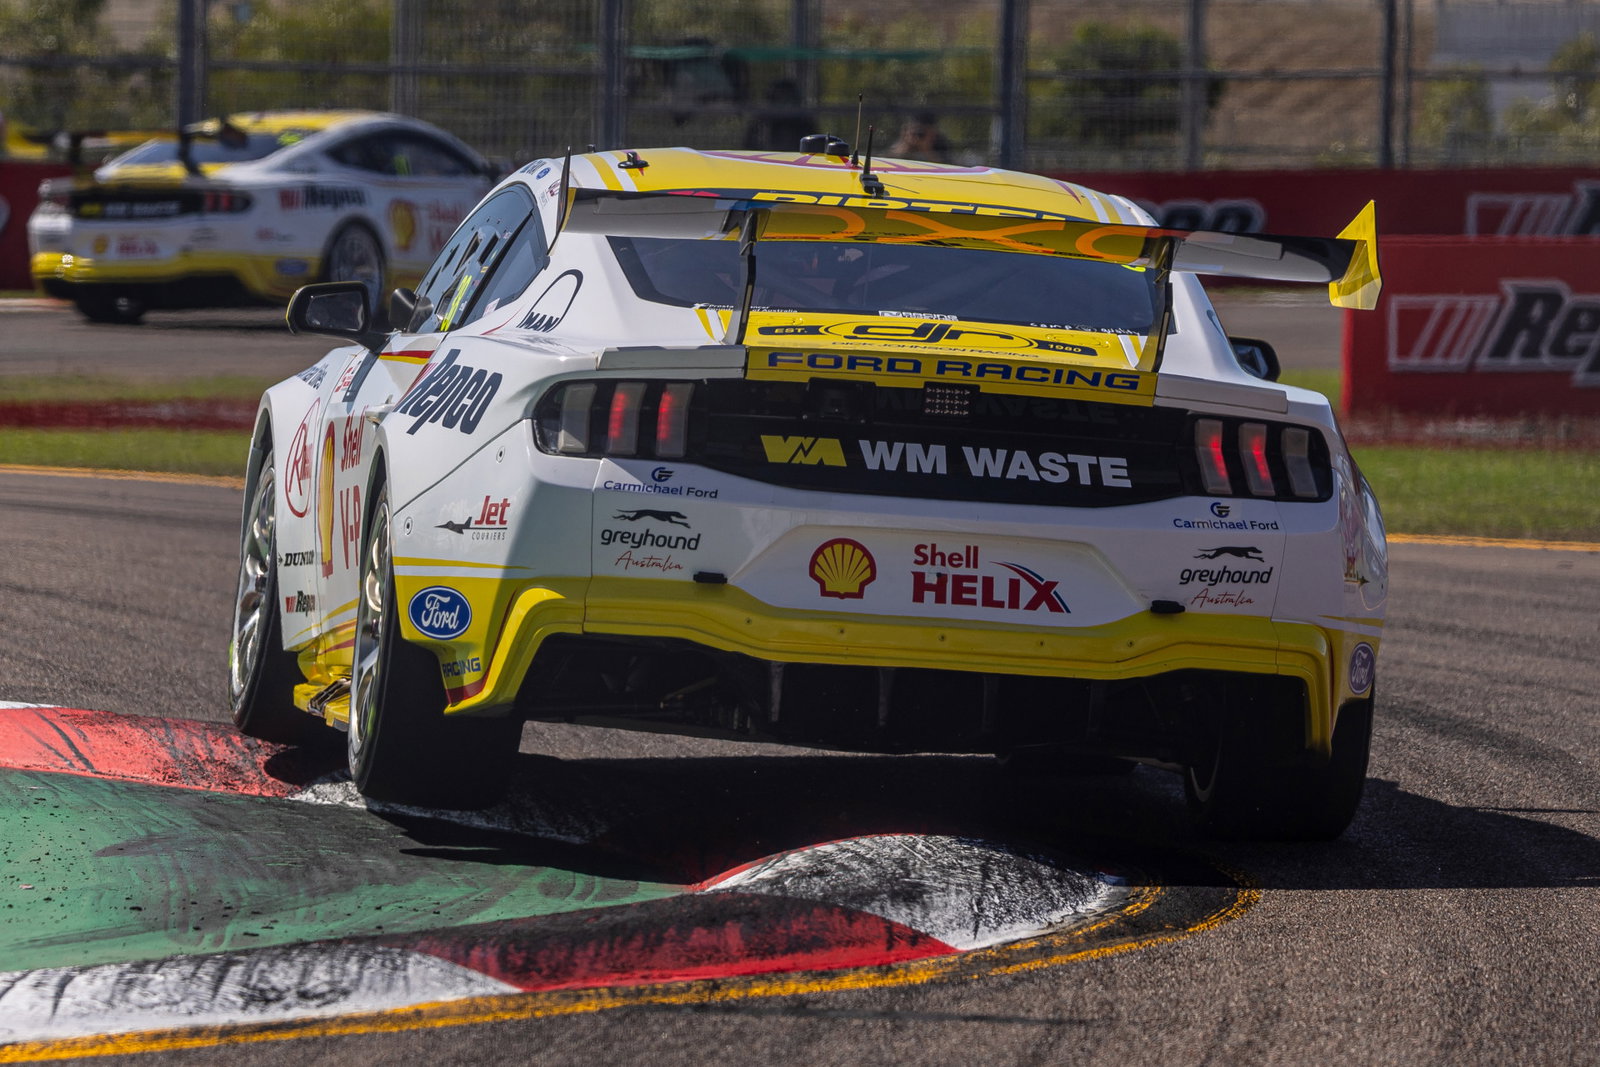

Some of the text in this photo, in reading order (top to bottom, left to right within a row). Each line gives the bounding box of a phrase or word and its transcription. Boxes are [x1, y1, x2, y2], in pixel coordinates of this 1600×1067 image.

[522, 311, 560, 333] MAN
[878, 344, 966, 352] JOHNSON
[968, 348, 1040, 359] RACING
[1048, 343, 1082, 353] 1980
[769, 351, 1139, 390] FORD RACING
[397, 349, 503, 434] Repco
[859, 440, 947, 475] WM
[963, 446, 1132, 488] WASTE
[603, 480, 719, 499] Carmichael Ford
[475, 495, 511, 525] Jet
[1173, 518, 1279, 530] Carmichael Ford
[471, 531, 506, 540] COURIERS
[601, 528, 701, 551] greyhound
[284, 549, 315, 567] DUNLOP
[615, 550, 684, 573] Australia
[913, 543, 979, 569] Shell
[911, 561, 1072, 613] HELIX
[1179, 565, 1274, 587] greyhound
[1191, 588, 1254, 609] Australia
[421, 593, 460, 631] Ford
[442, 656, 481, 677] RACING
[1352, 649, 1371, 685] Ford
